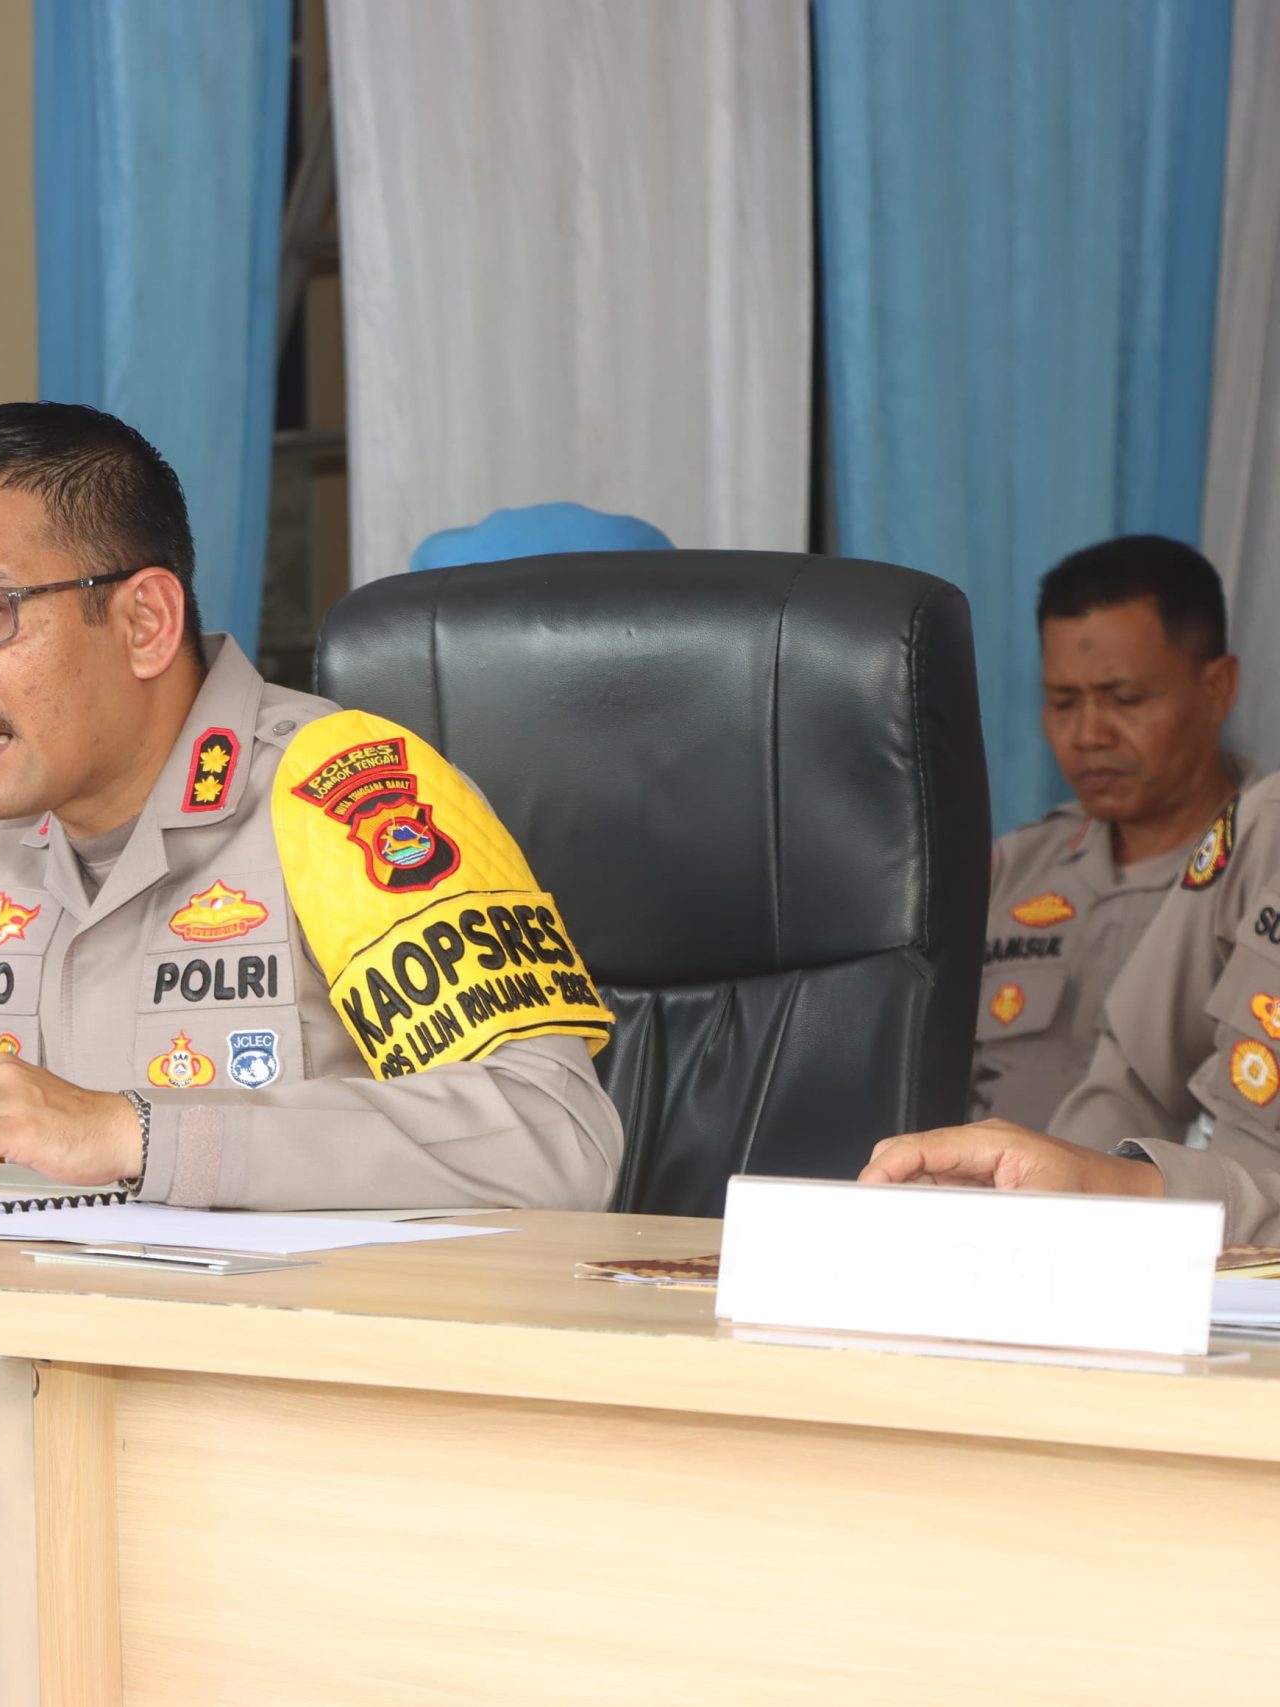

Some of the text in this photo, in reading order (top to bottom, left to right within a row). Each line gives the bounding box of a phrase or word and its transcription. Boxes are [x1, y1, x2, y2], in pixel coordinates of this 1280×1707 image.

[308, 745, 394, 789] POLRES
[355, 754, 399, 771] TENGAH
[154, 954, 278, 1005] POLRI
[342, 905, 576, 1059] KAOPSRES
[233, 1035, 272, 1048] JCLEC
[406, 1003, 464, 1066] LILIN
[456, 971, 550, 1028] RINJANI
